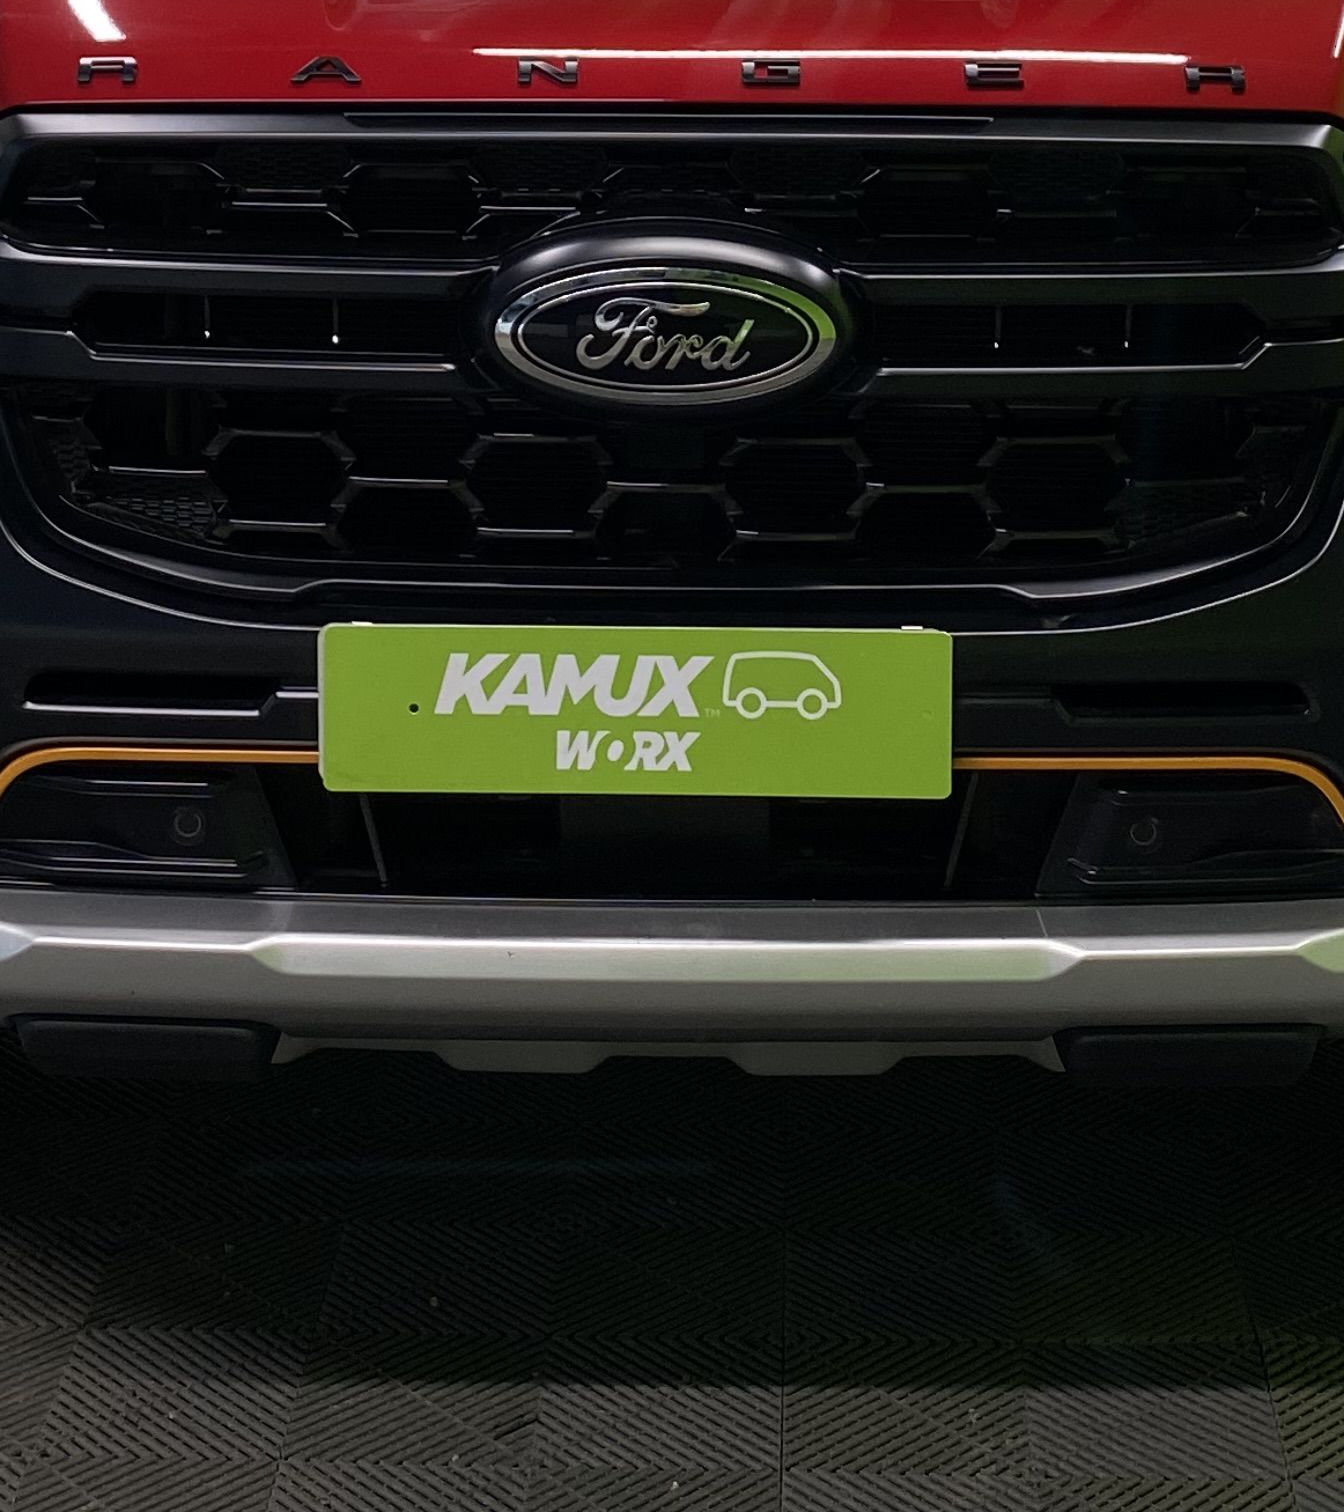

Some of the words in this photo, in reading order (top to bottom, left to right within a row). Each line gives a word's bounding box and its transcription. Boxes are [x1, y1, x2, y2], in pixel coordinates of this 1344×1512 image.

[76, 55, 1247, 92] RANGER
[575, 296, 755, 371] Ford
[434, 652, 715, 718] KAMUX
